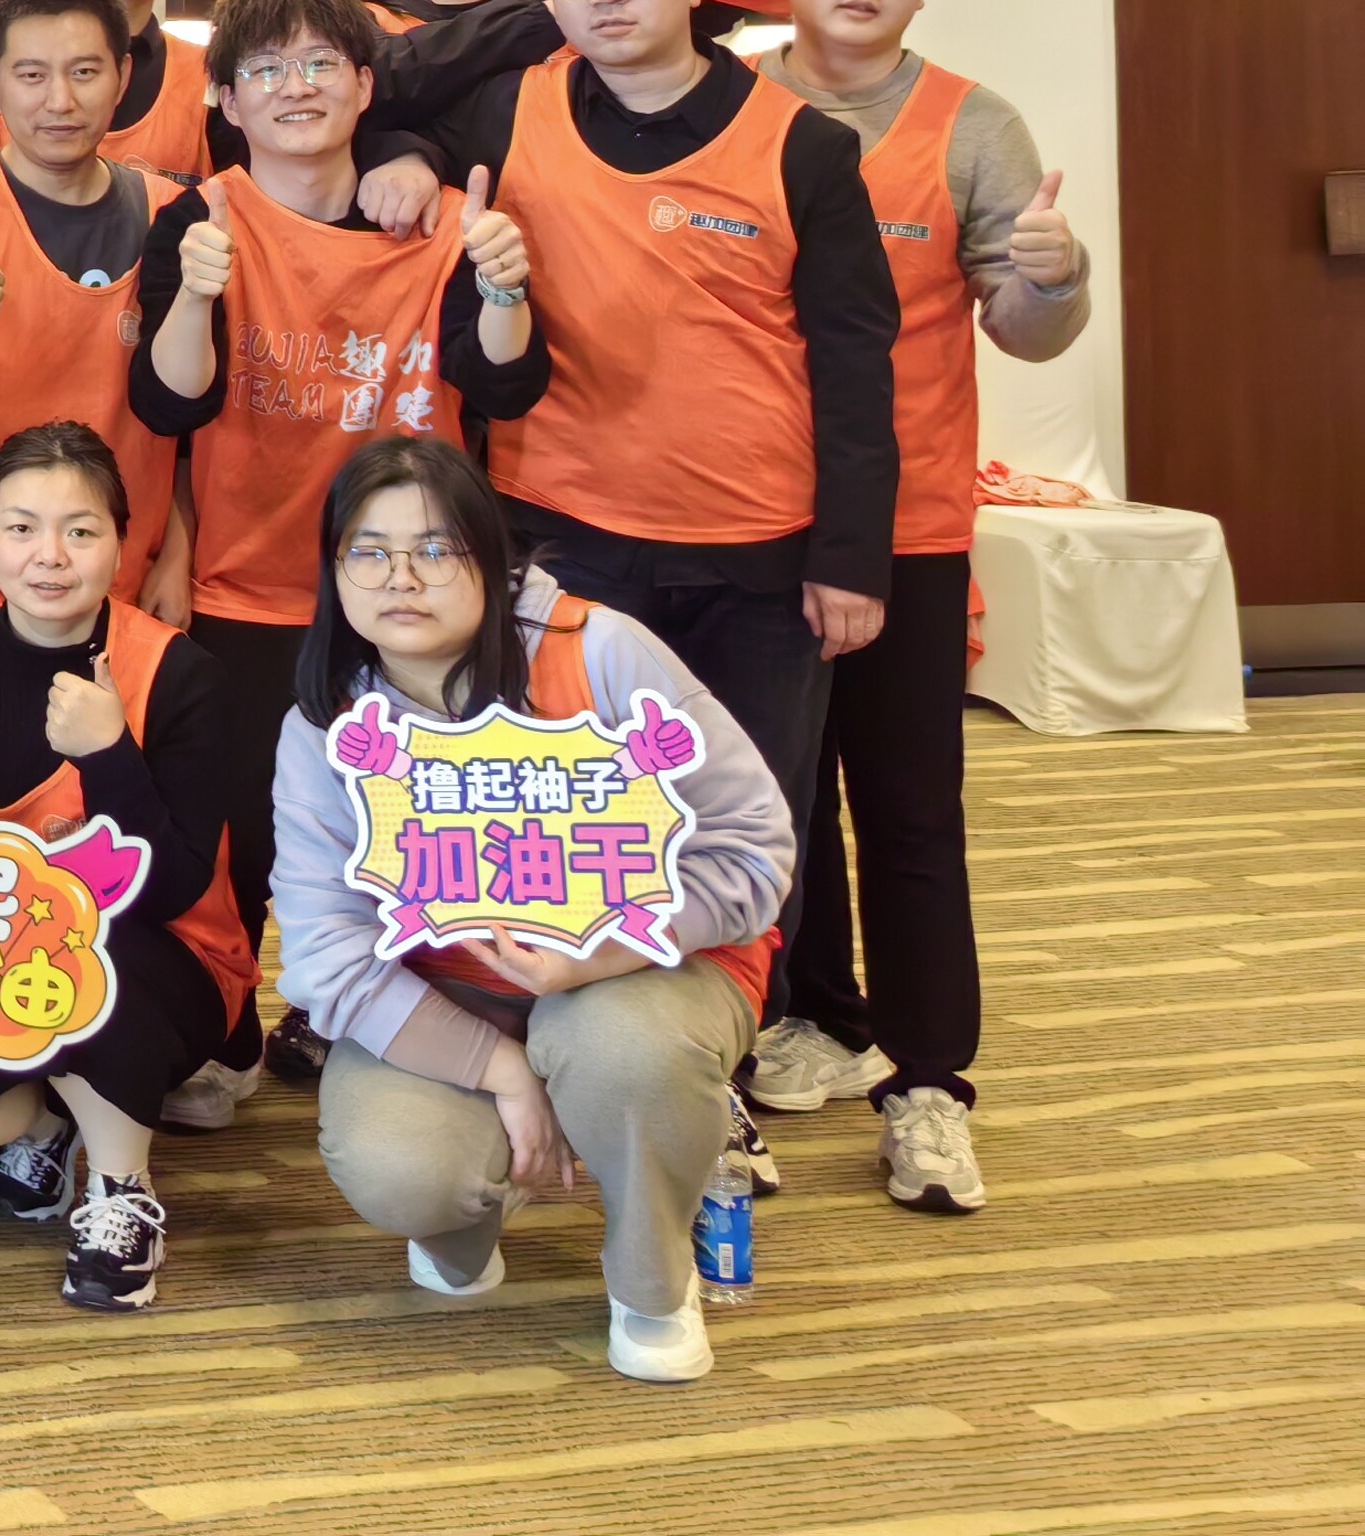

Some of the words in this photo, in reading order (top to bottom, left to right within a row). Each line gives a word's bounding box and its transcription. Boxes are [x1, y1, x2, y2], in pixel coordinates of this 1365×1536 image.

[412, 759, 626, 812] 撸起袖子
[397, 820, 655, 905] 加油干
